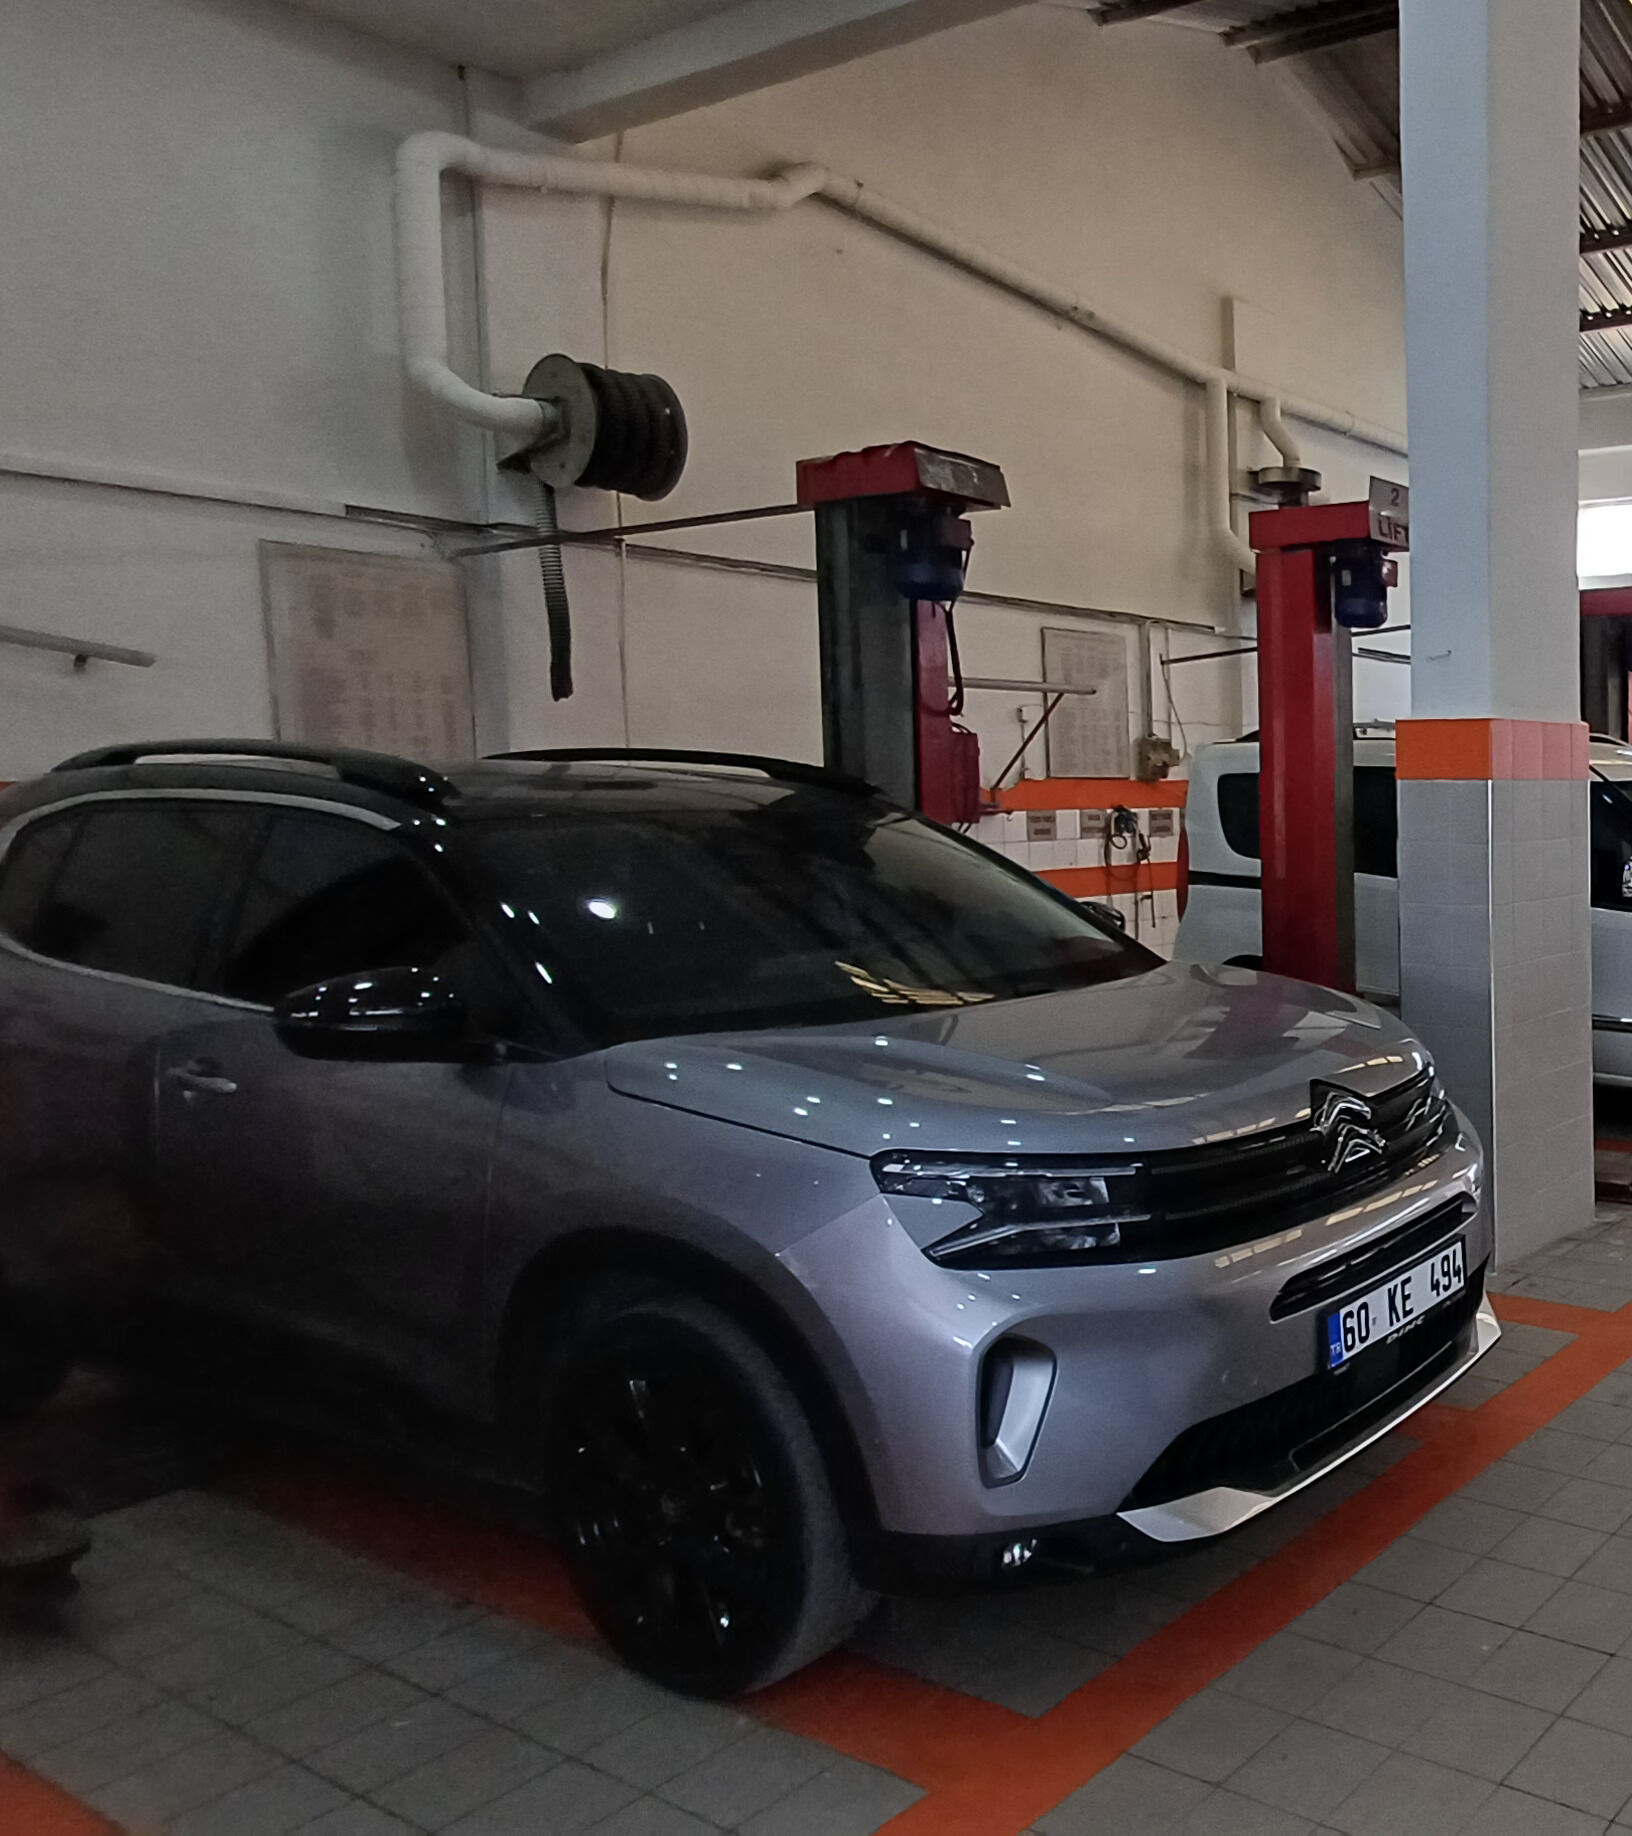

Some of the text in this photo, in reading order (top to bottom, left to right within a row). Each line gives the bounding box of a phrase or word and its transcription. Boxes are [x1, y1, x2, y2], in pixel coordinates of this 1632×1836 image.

[1390, 487, 1400, 507] 2
[1342, 1248, 1462, 1353] 60 KE 494
